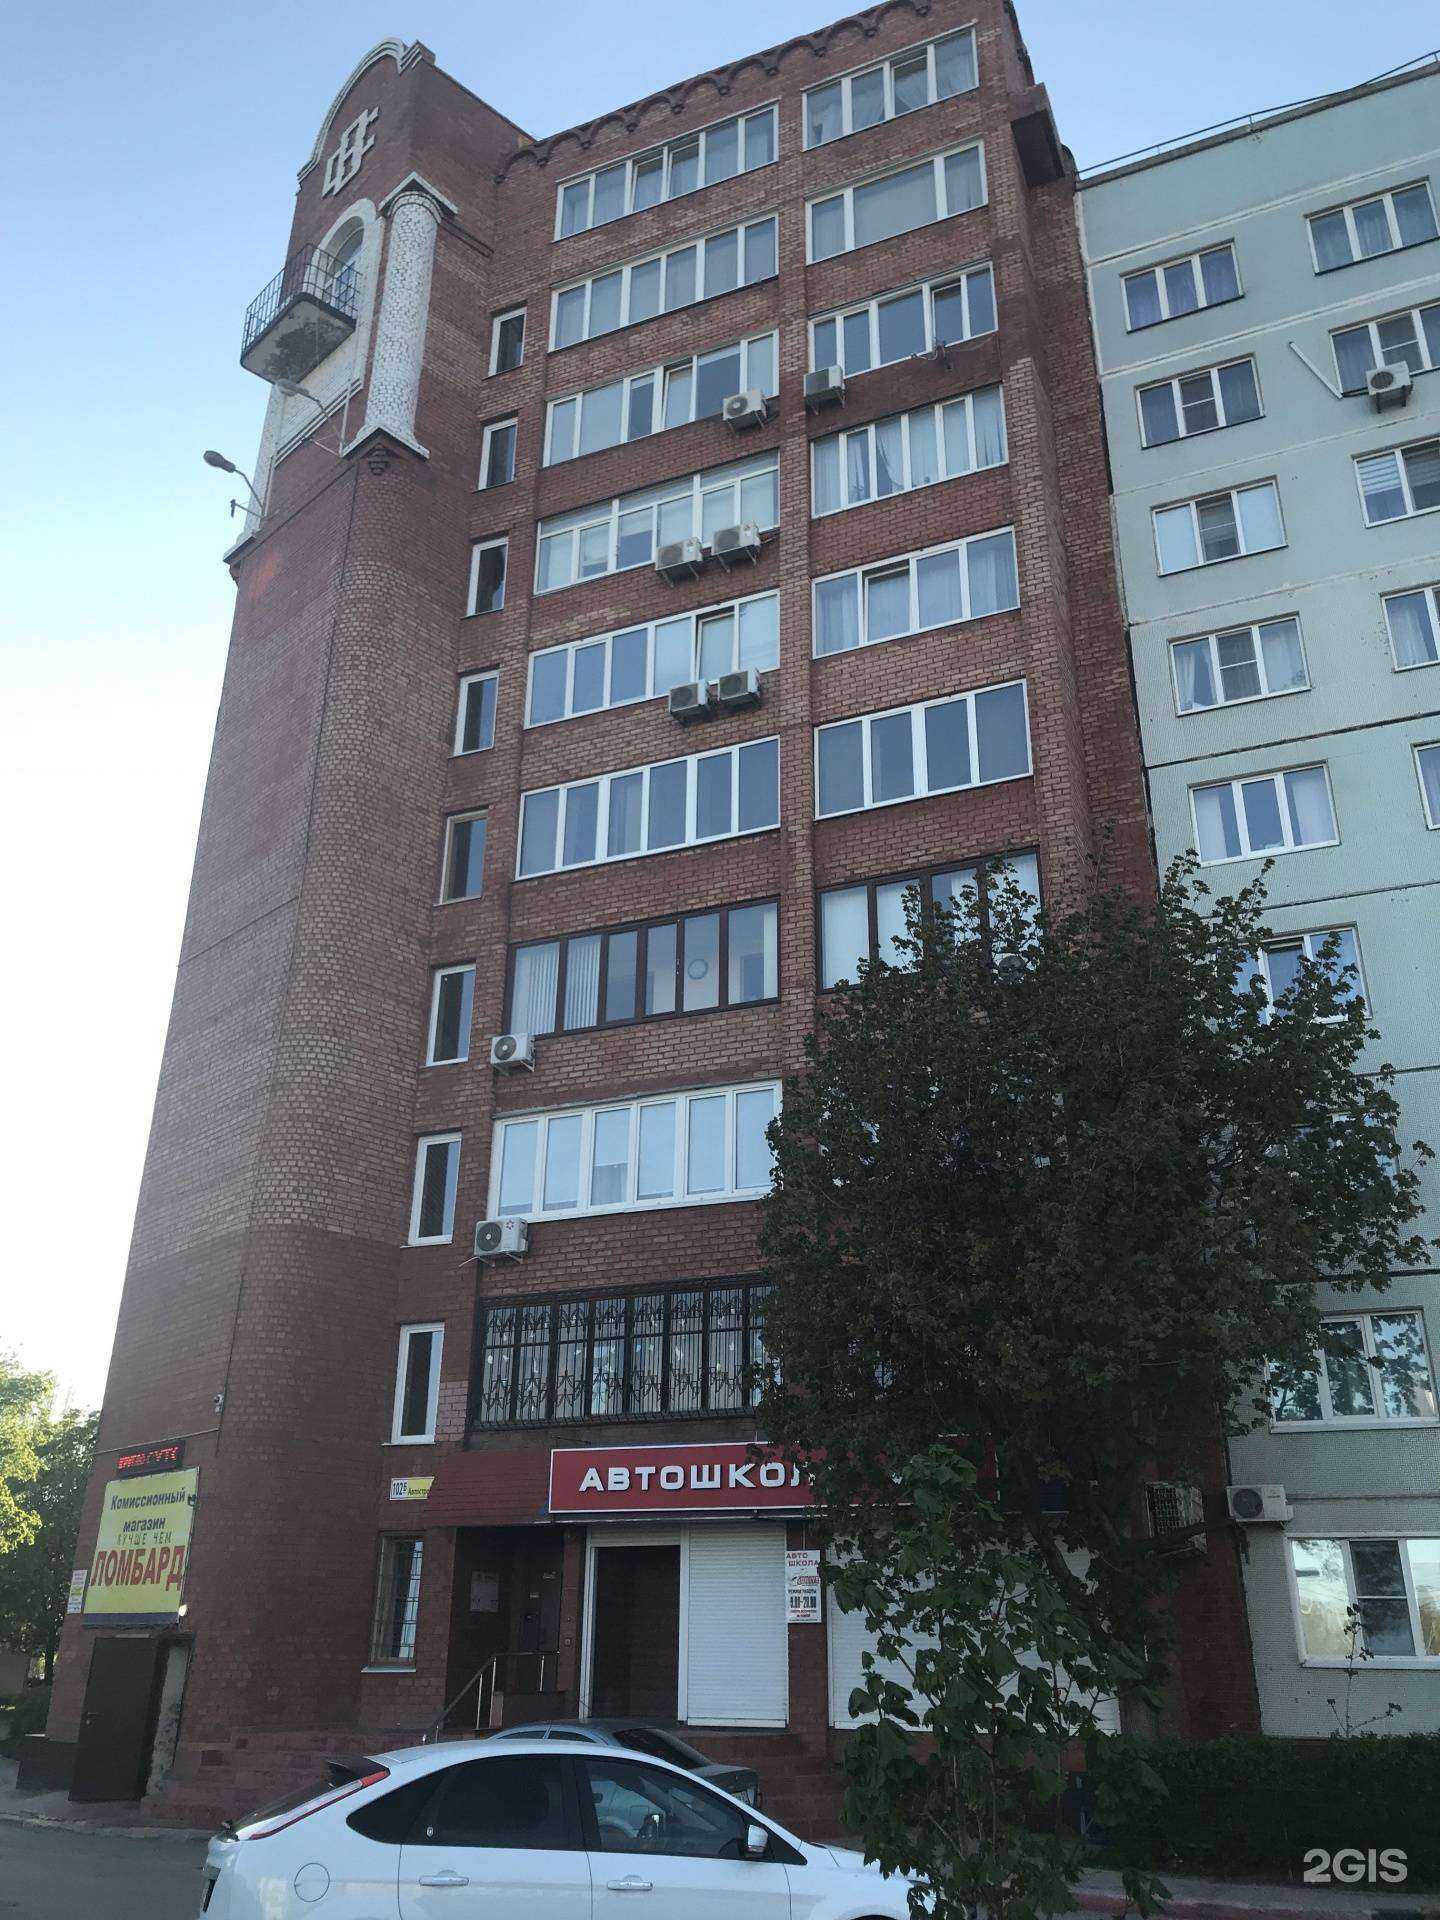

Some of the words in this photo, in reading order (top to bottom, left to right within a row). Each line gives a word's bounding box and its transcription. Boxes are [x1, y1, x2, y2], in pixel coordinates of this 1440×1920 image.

[579, 1461, 816, 1492] АВТОШКОЛ
[111, 1487, 186, 1511] Комиссионный
[123, 1517, 166, 1533] магазин
[153, 1532, 172, 1544] ЧЕМ
[91, 1545, 186, 1592] ЛОМБАРД
